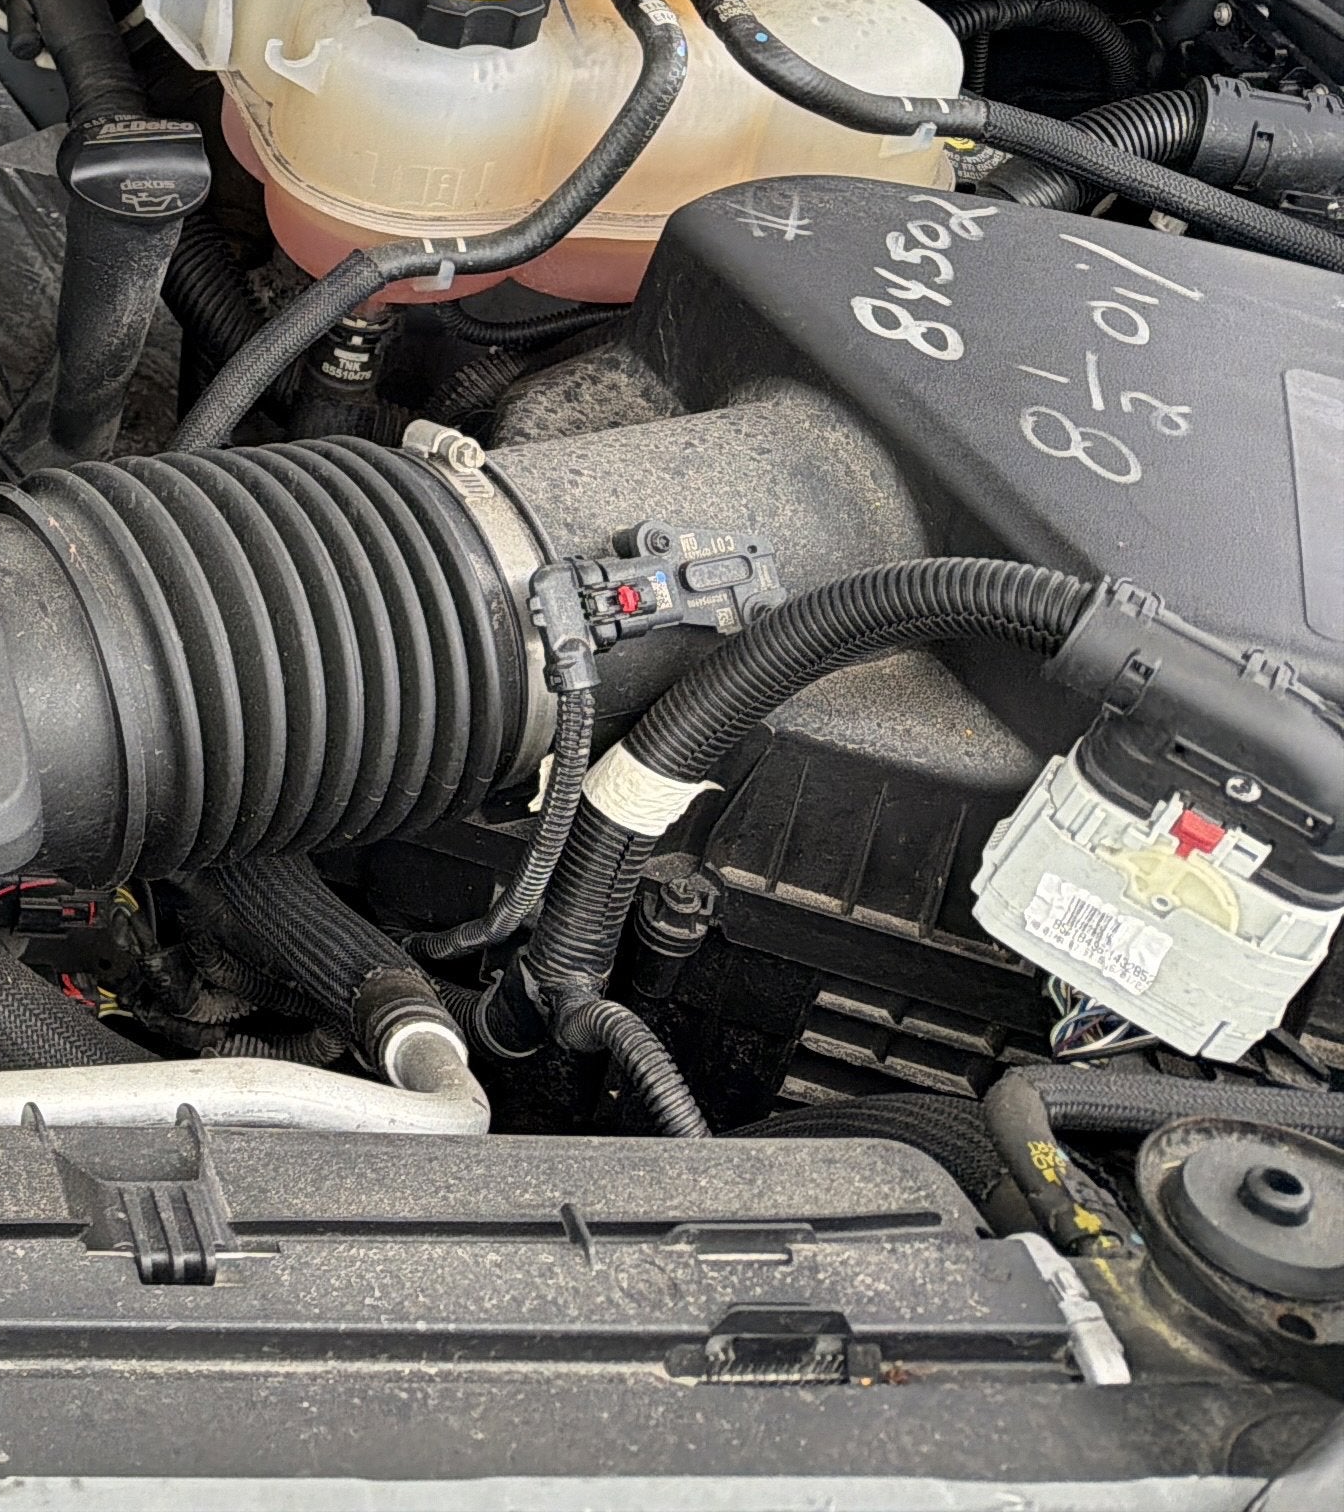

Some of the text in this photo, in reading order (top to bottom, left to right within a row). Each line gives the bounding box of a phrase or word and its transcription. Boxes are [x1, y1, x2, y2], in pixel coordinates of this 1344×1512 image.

[98, 119, 195, 136] ACDelco
[119, 179, 177, 191] dexos
[850, 194, 999, 361] 84502
[338, 357, 362, 372] TNK
